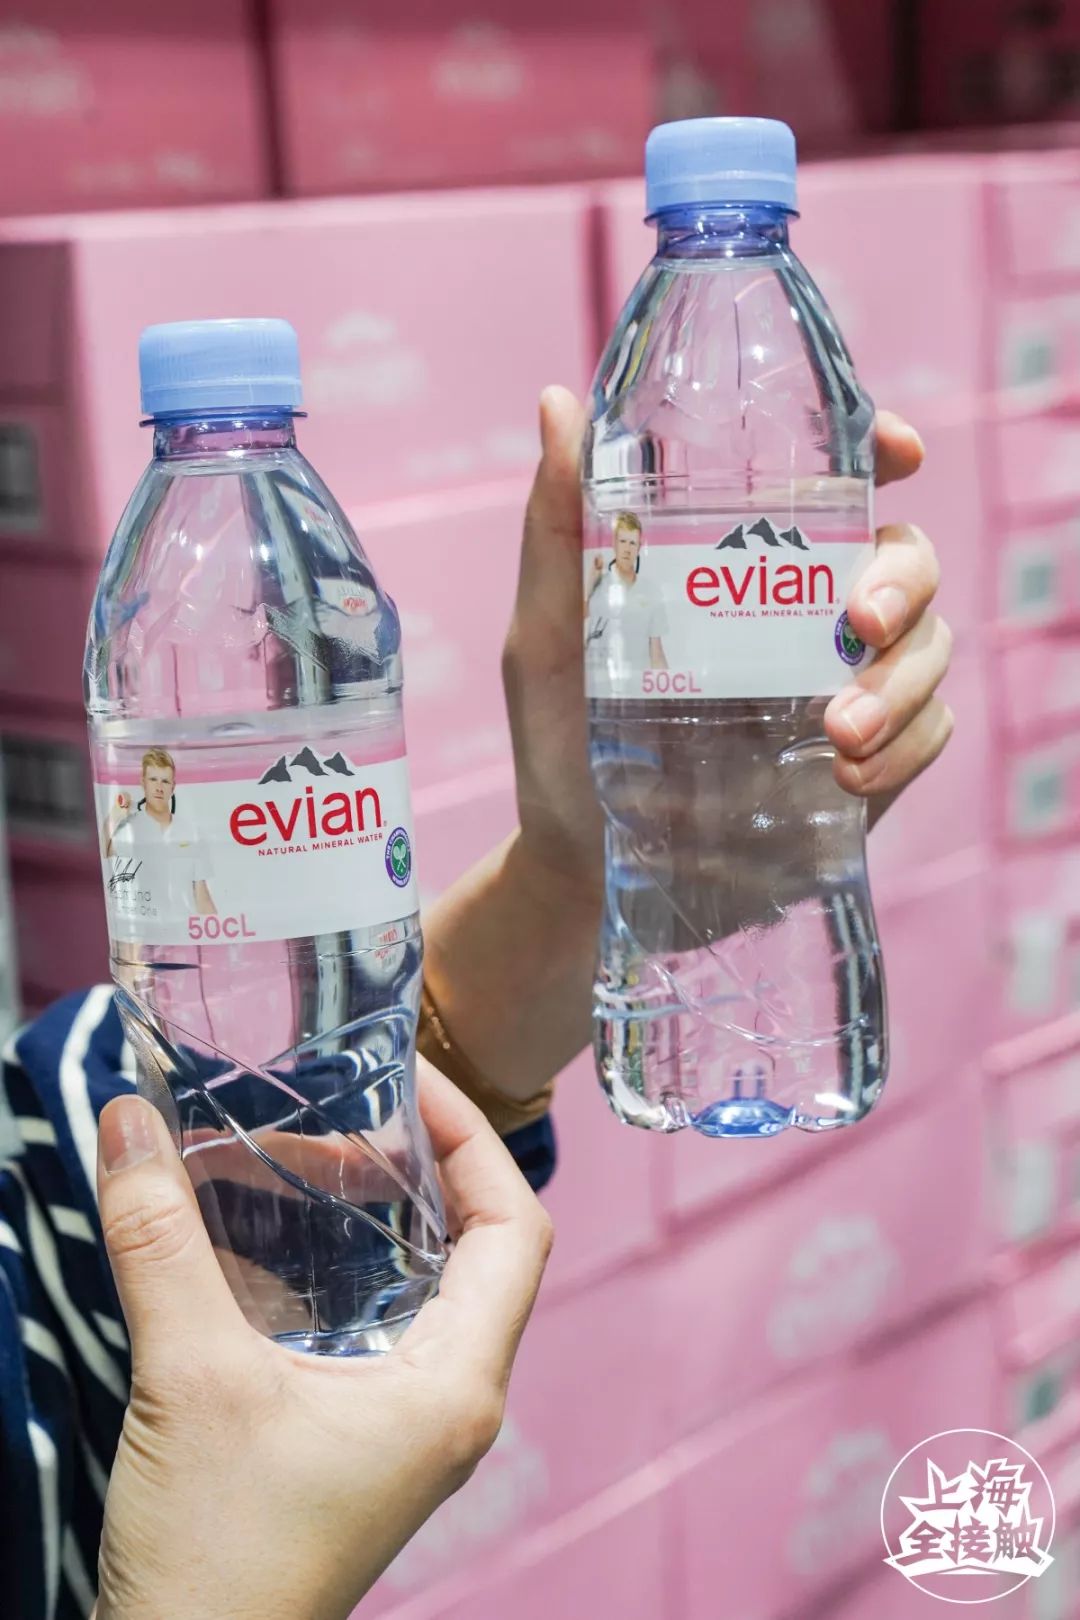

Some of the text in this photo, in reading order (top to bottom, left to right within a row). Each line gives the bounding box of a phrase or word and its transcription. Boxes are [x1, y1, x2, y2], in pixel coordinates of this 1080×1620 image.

[686, 555, 835, 607] evian
[709, 608, 835, 618] NATURAL MINERAL WATER
[229, 785, 382, 846] evian
[258, 845, 308, 857] NATURAL
[311, 838, 355, 852] MINERAL
[357, 832, 384, 844] WATER
